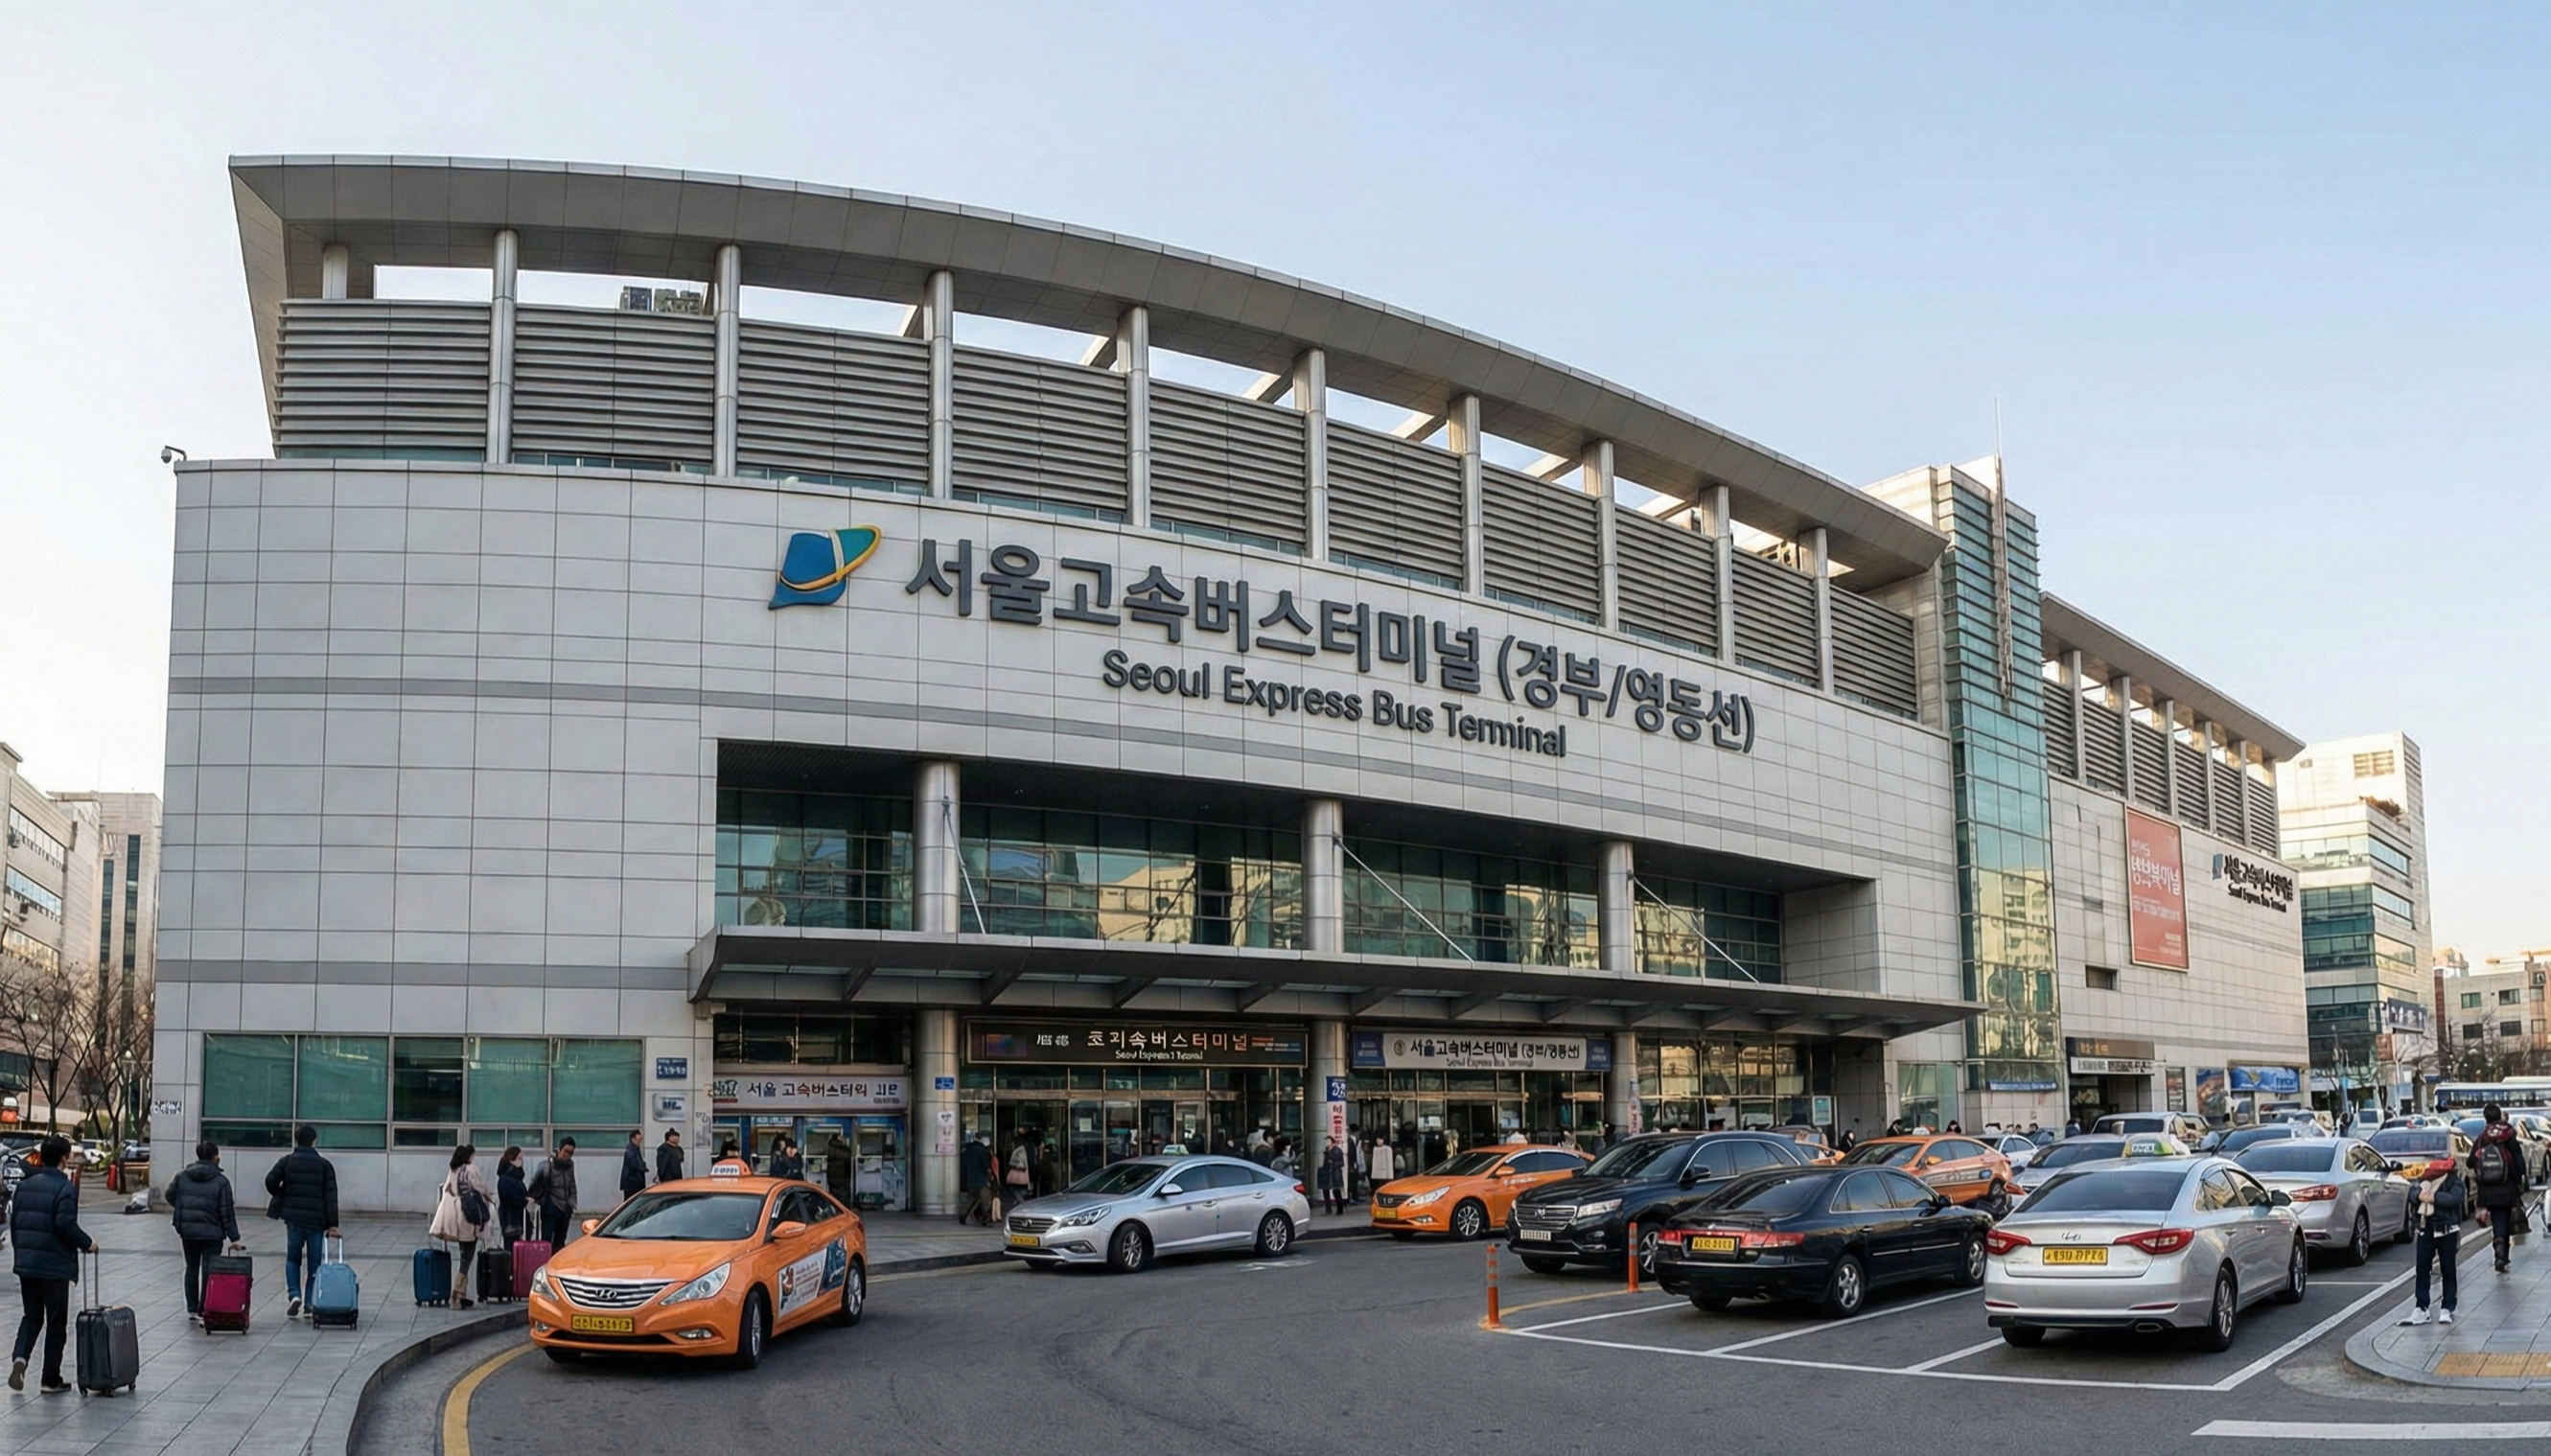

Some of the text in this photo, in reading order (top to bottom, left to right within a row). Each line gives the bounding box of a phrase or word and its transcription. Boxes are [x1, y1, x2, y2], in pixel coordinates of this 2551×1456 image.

[905, 539, 1754, 753] 서울고속버스터미널 (경부/영동선)
[1102, 649, 1565, 757] Seoul Express Bus Terminal
